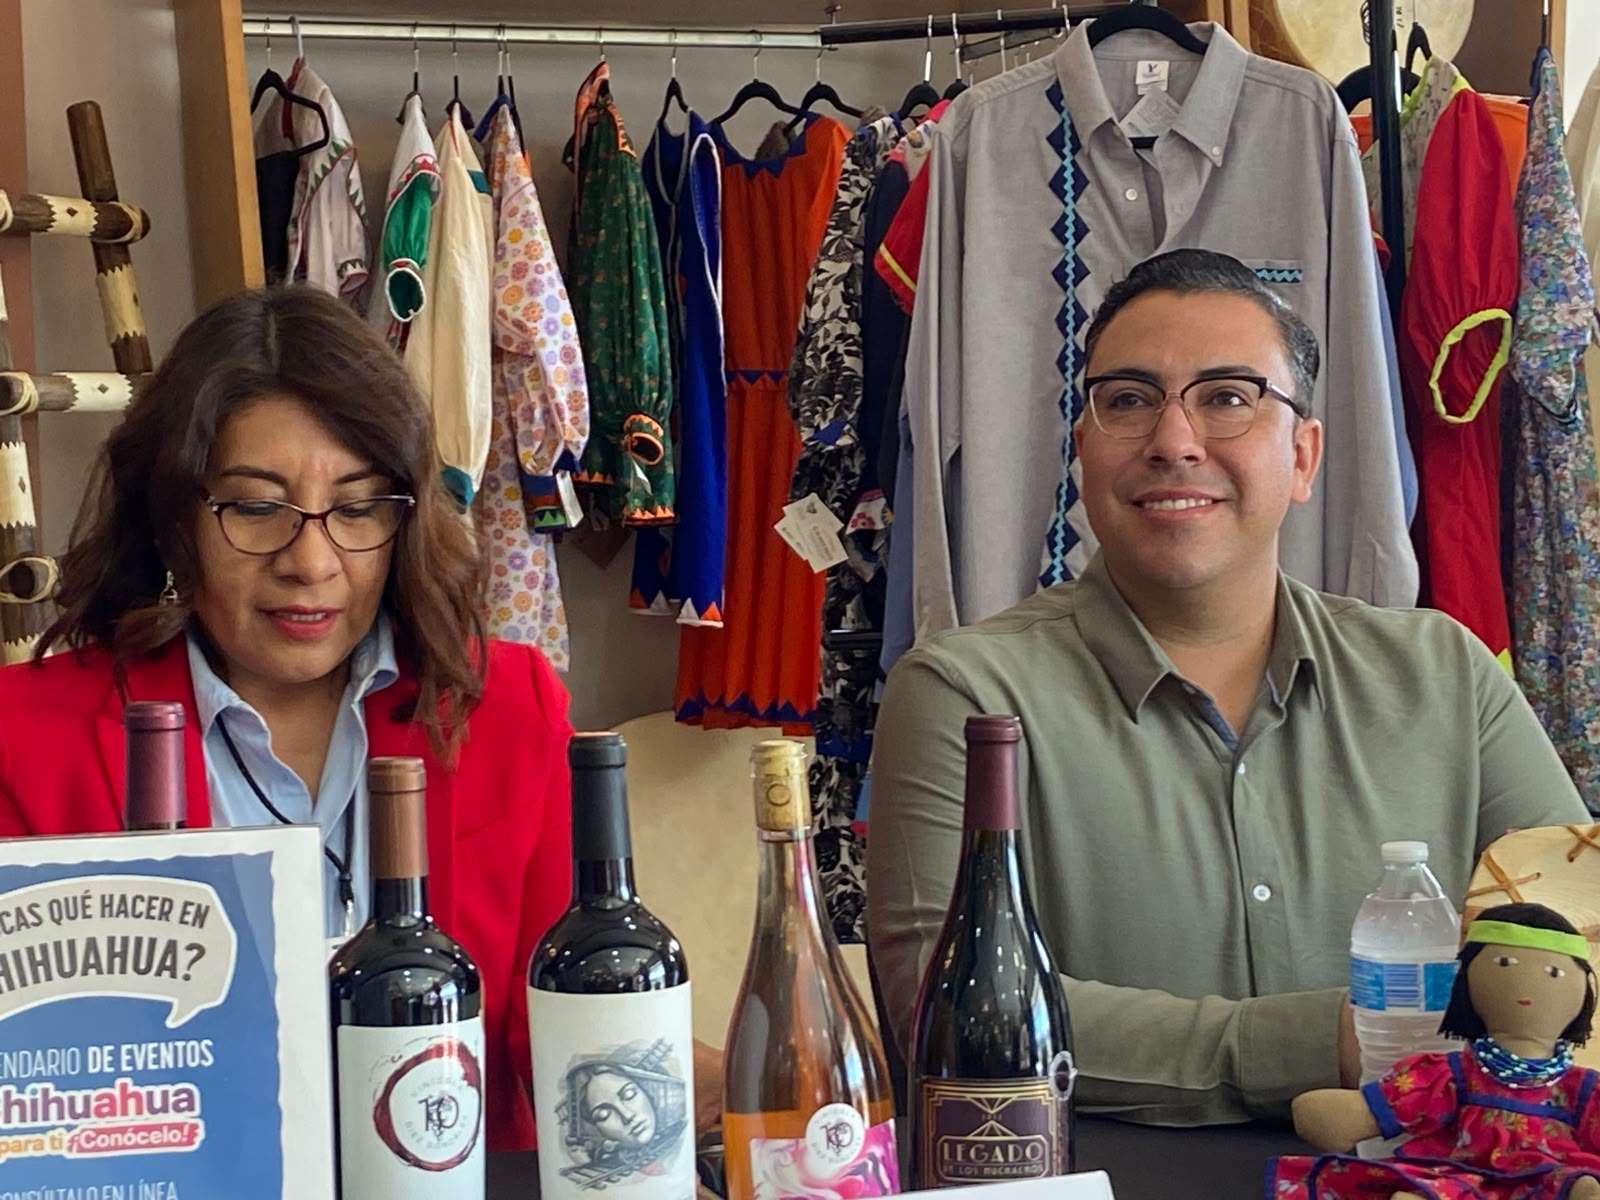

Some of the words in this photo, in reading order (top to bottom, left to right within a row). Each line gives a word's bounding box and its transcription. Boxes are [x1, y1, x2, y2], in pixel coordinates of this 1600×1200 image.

[48, 889, 93, 926] QUÉ
[100, 893, 173, 922] HACER
[179, 900, 210, 929] EN
[0, 1047, 80, 1079] NDARIO
[88, 1045, 115, 1074] DE
[121, 1039, 214, 1071] EVENTOS
[50, 1131, 63, 1151] ti
[72, 1122, 189, 1154] ¡Conócelo!
[943, 1141, 1044, 1163] LEGADO
